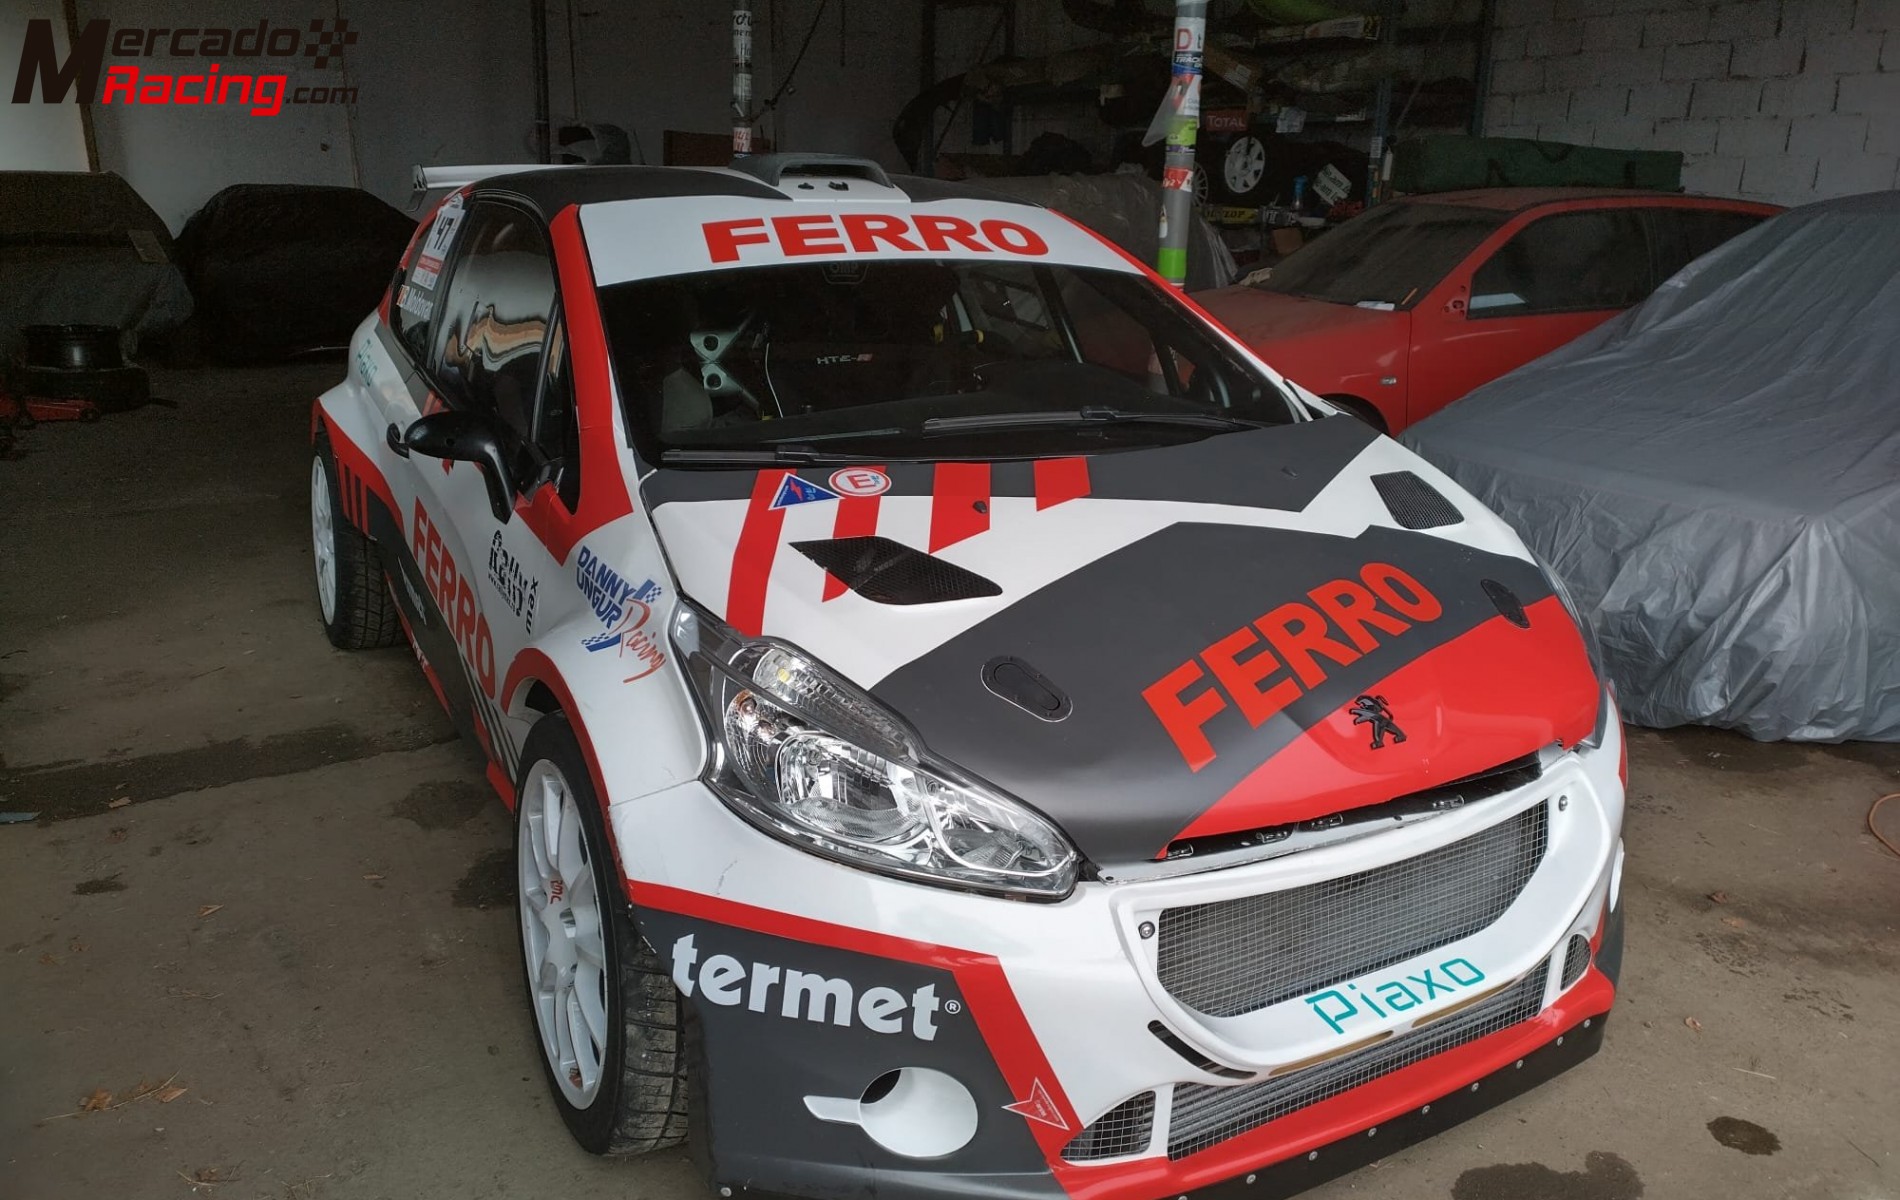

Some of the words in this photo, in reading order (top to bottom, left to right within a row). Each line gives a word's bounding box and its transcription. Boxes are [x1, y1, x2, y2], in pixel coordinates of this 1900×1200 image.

[1207, 114, 1247, 129] TOTAL
[702, 213, 1049, 263] FERRO
[413, 495, 496, 700] FERRO
[576, 566, 623, 630] UNGUR
[577, 545, 637, 606] DANNY
[608, 598, 667, 684] Racing
[1141, 562, 1443, 773] FERRO
[1304, 957, 1486, 1035] Piaxo
